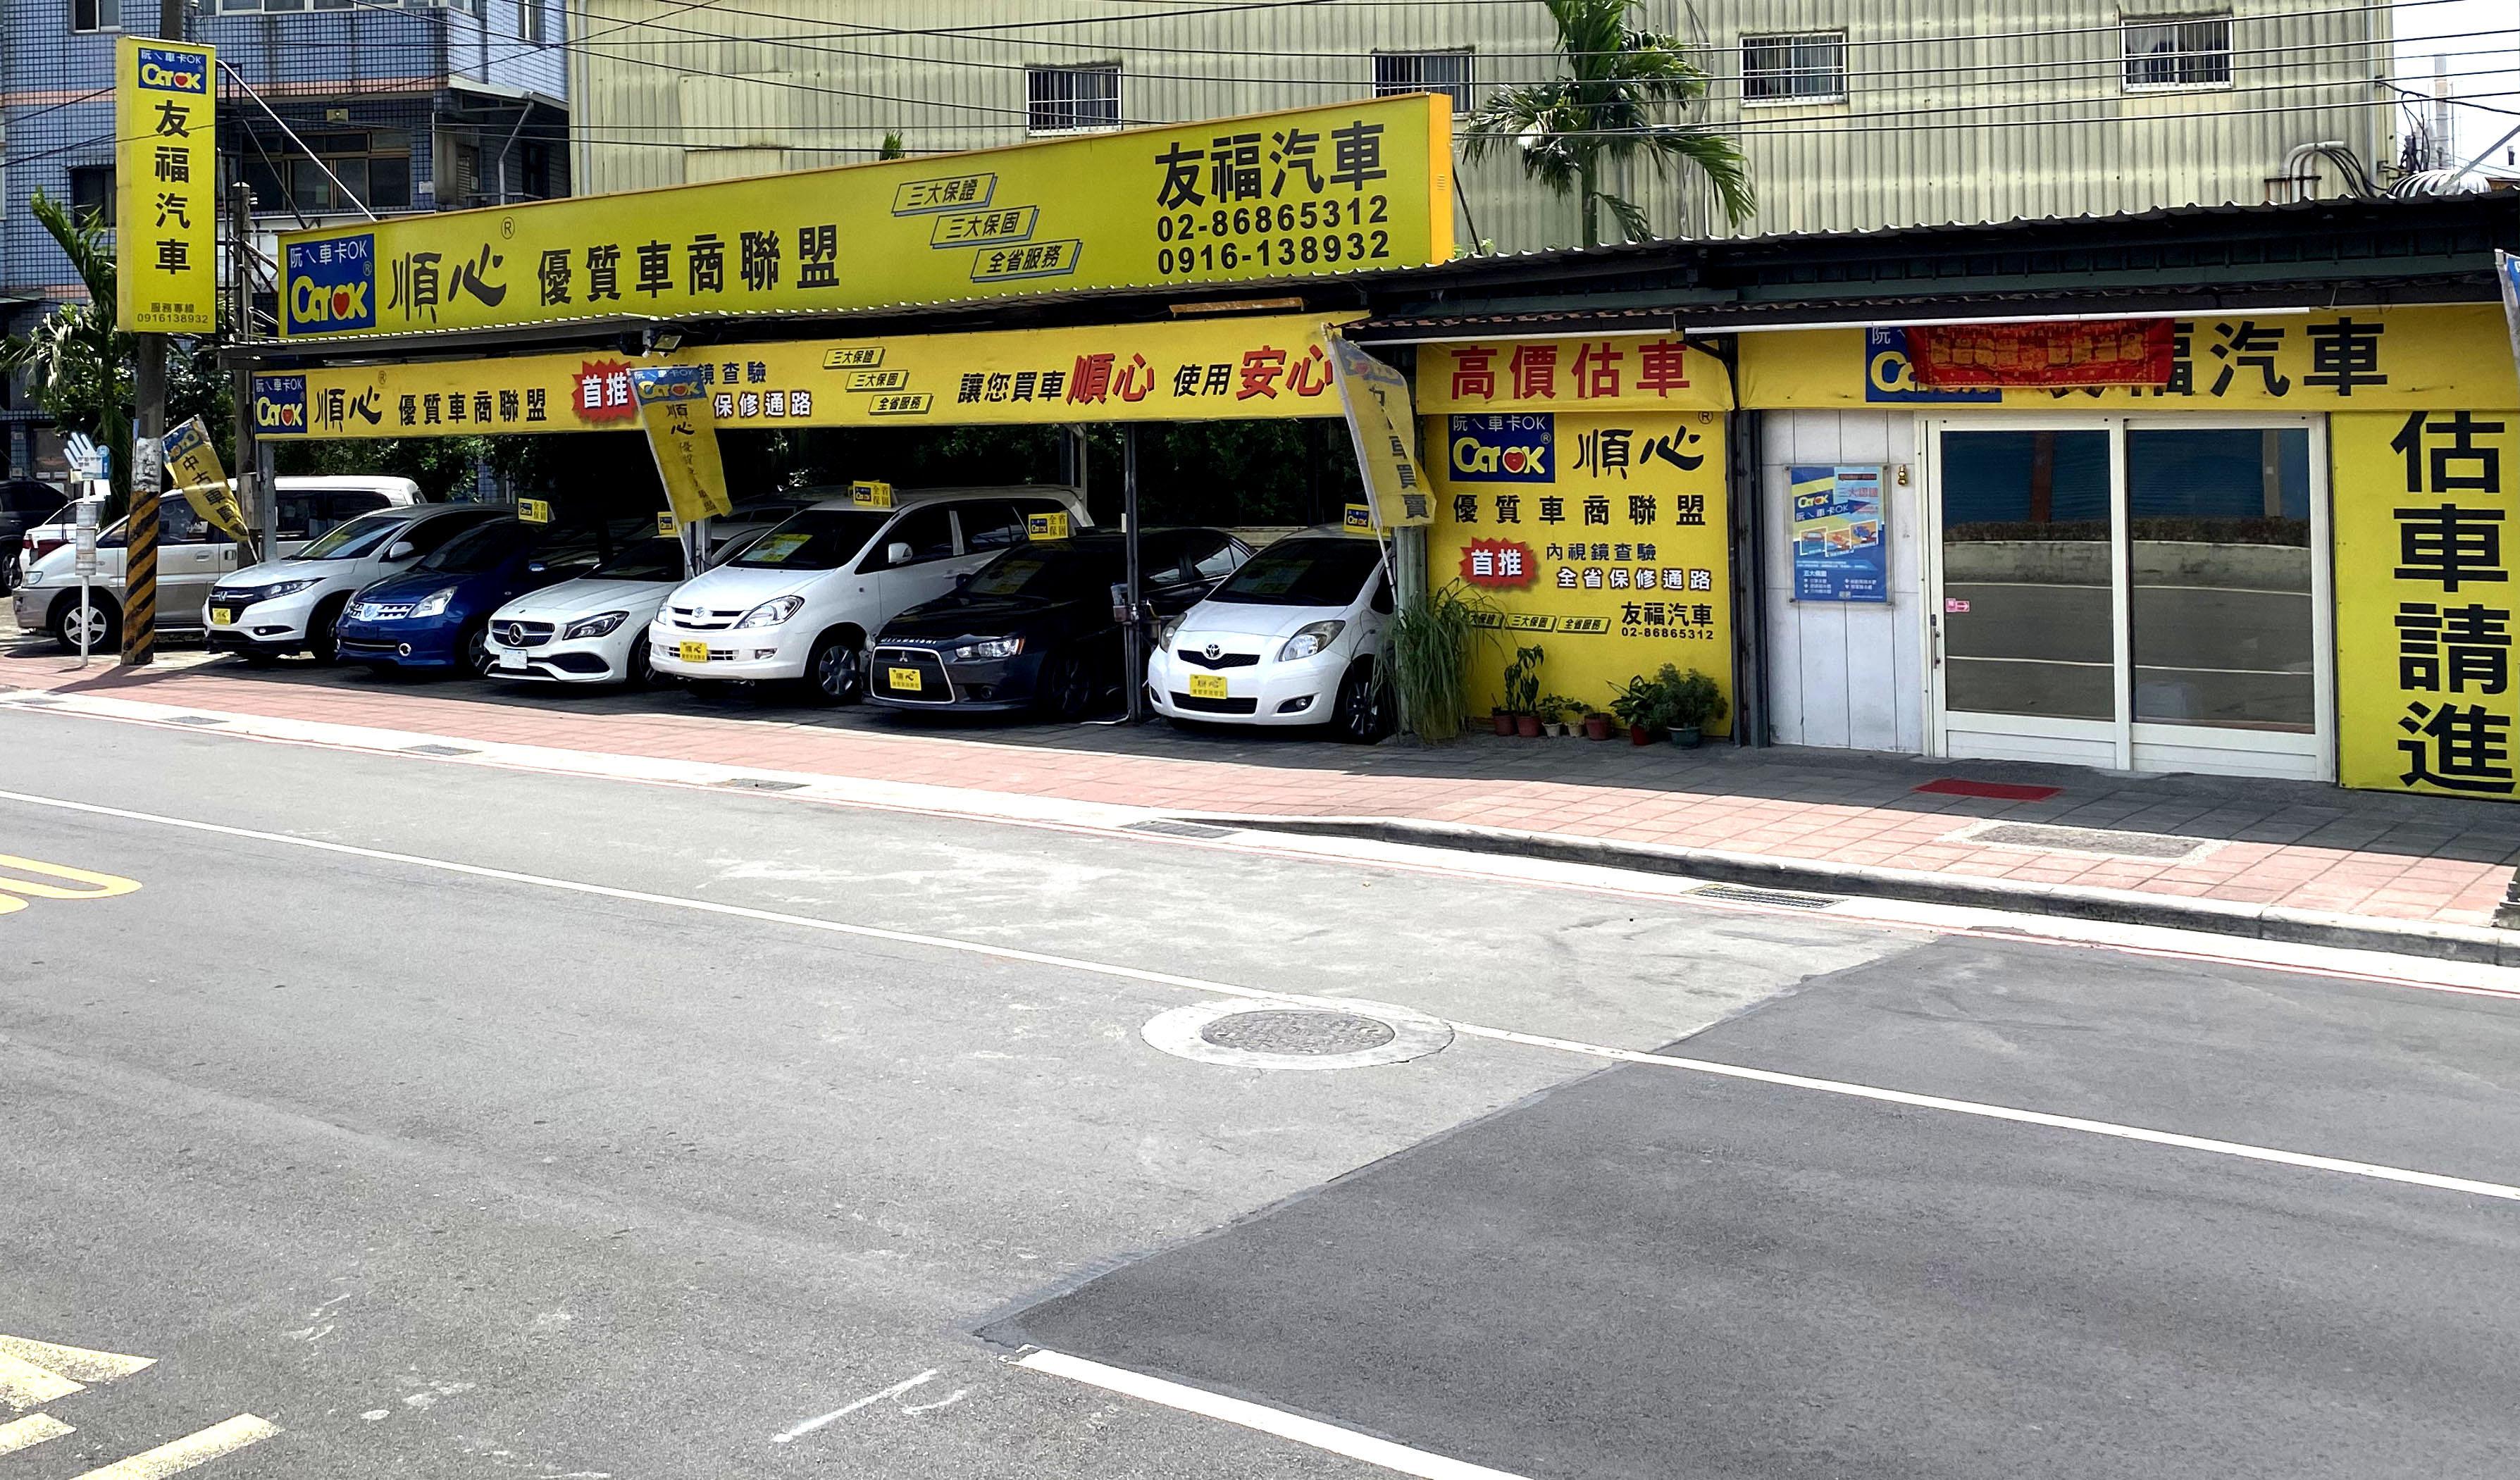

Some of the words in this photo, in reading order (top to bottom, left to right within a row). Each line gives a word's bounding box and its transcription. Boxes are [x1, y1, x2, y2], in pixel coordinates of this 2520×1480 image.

[1155, 120, 1387, 211] 友福汽車
[154, 99, 191, 275] 友福汽車
[907, 179, 978, 206] 三大保證
[946, 212, 1020, 239] 三大保固
[1157, 194, 1389, 242] 02-86865312
[986, 245, 1062, 274] 全省服務
[1158, 230, 1389, 274] 0916-138932
[387, 243, 507, 324] 順心
[537, 224, 840, 306] 優質車商聯盟
[137, 313, 209, 325] 0916138932
[1173, 344, 1334, 401] 使用安心
[1451, 339, 1689, 400] 高價估車
[314, 385, 383, 432] 順心
[399, 388, 547, 426] 優質車商聯盟
[582, 372, 628, 409] 首推
[1572, 425, 1704, 480] 順心
[1453, 495, 1706, 526] 優質車商聯盟
[1471, 549, 1522, 577] 首推
[1546, 543, 1656, 561] 內視鏡查驗
[1558, 568, 1712, 590] 全省保修通路
[1620, 601, 1714, 628] 友福汽車
[2390, 410, 2517, 794] 估車請進
[1621, 627, 1714, 640] 02-86865312
